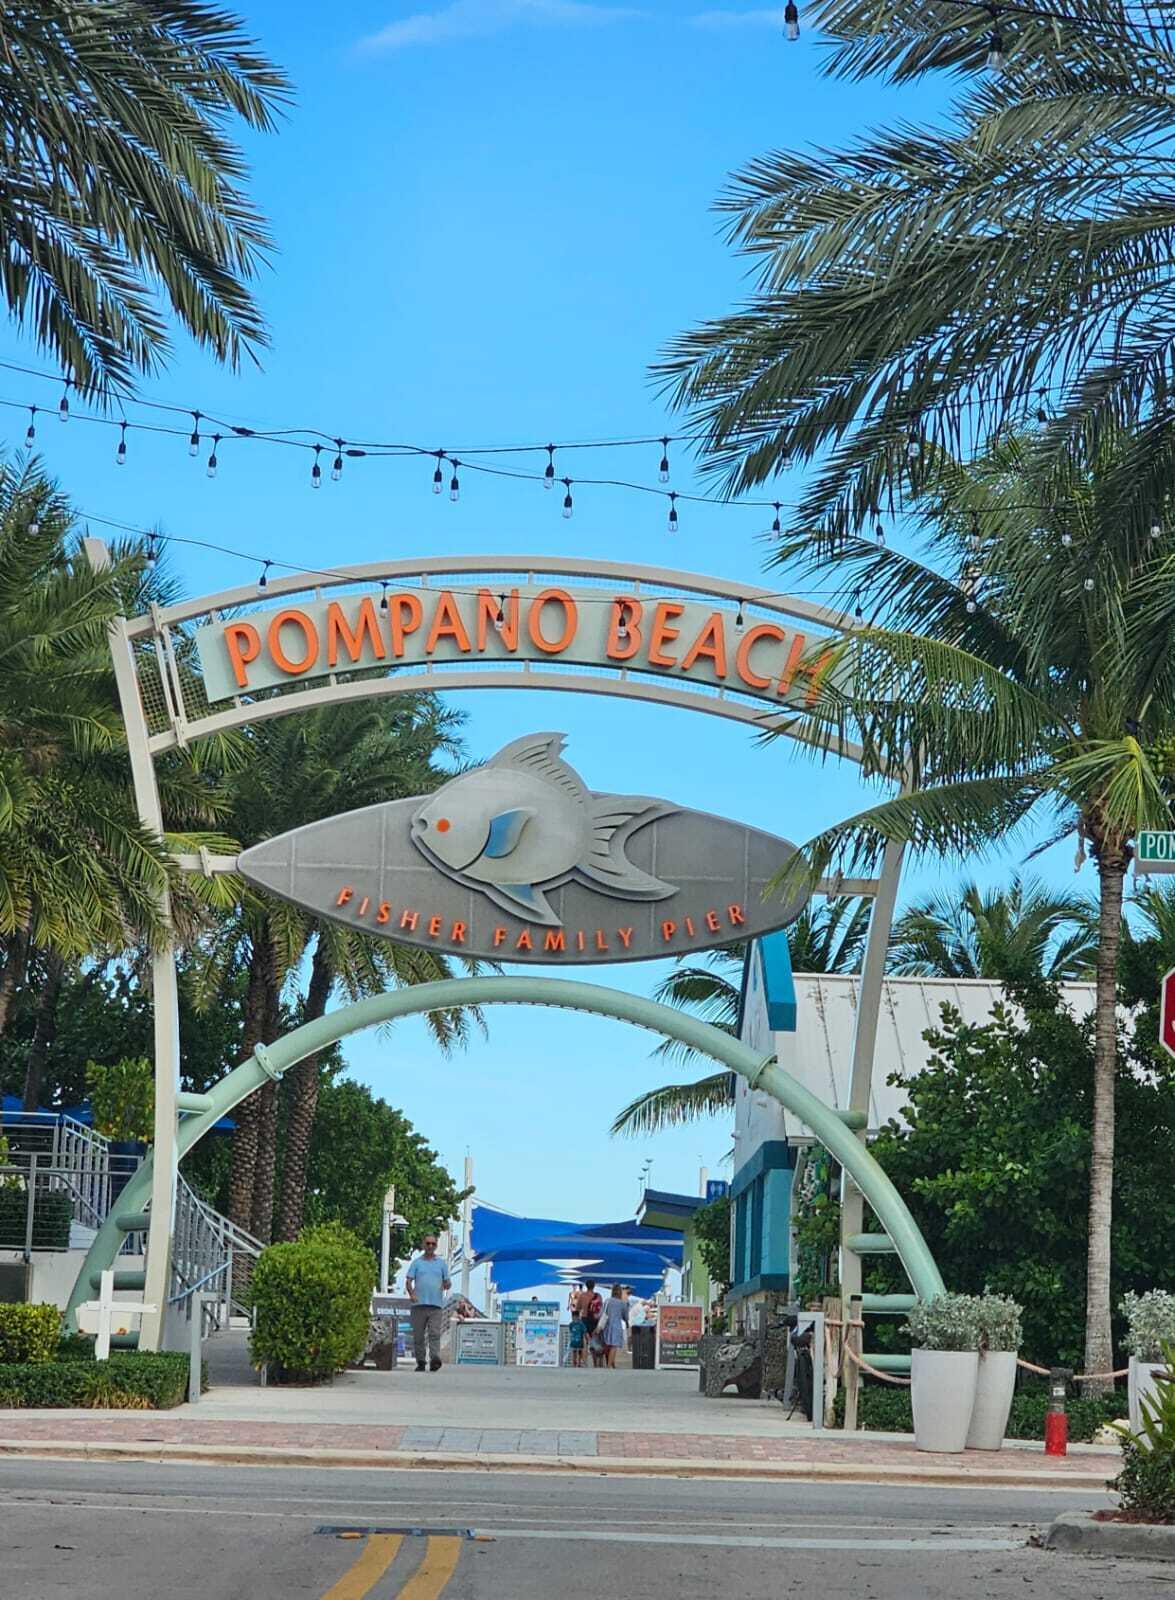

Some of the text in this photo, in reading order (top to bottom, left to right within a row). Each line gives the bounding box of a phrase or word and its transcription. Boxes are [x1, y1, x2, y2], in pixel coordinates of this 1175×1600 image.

[224, 587, 832, 705] POMPANO BEACH
[336, 886, 745, 951] FISHER FAMILY PIER
